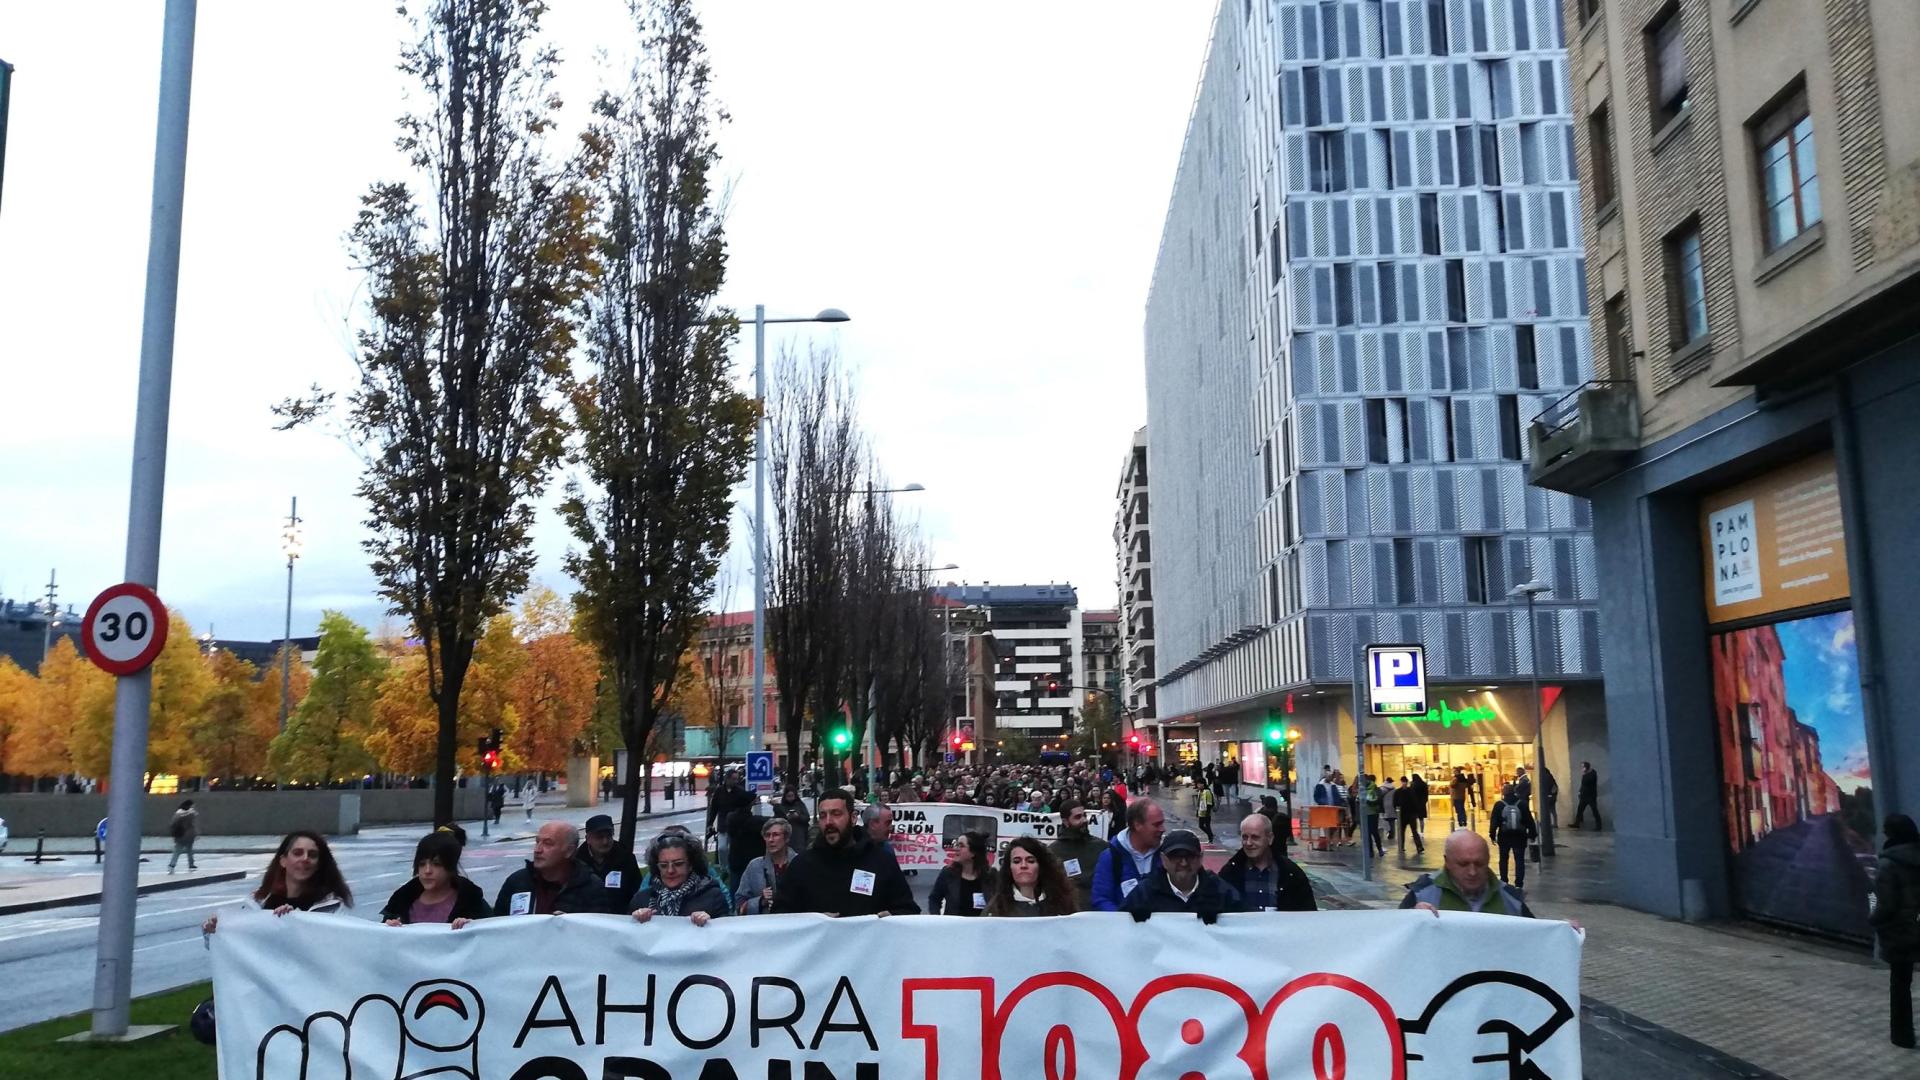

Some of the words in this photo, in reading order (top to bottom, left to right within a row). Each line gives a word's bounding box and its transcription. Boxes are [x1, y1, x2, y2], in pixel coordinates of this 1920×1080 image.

[1717, 513, 1748, 537] PAM
[1718, 537, 1750, 559] PLO
[1720, 562, 1740, 582] NA
[100, 612, 147, 641] 30
[1379, 652, 1413, 687] P
[1004, 813, 1052, 823] DIGNA
[896, 855, 939, 865] ERAL
[513, 974, 879, 1051] AHORA
